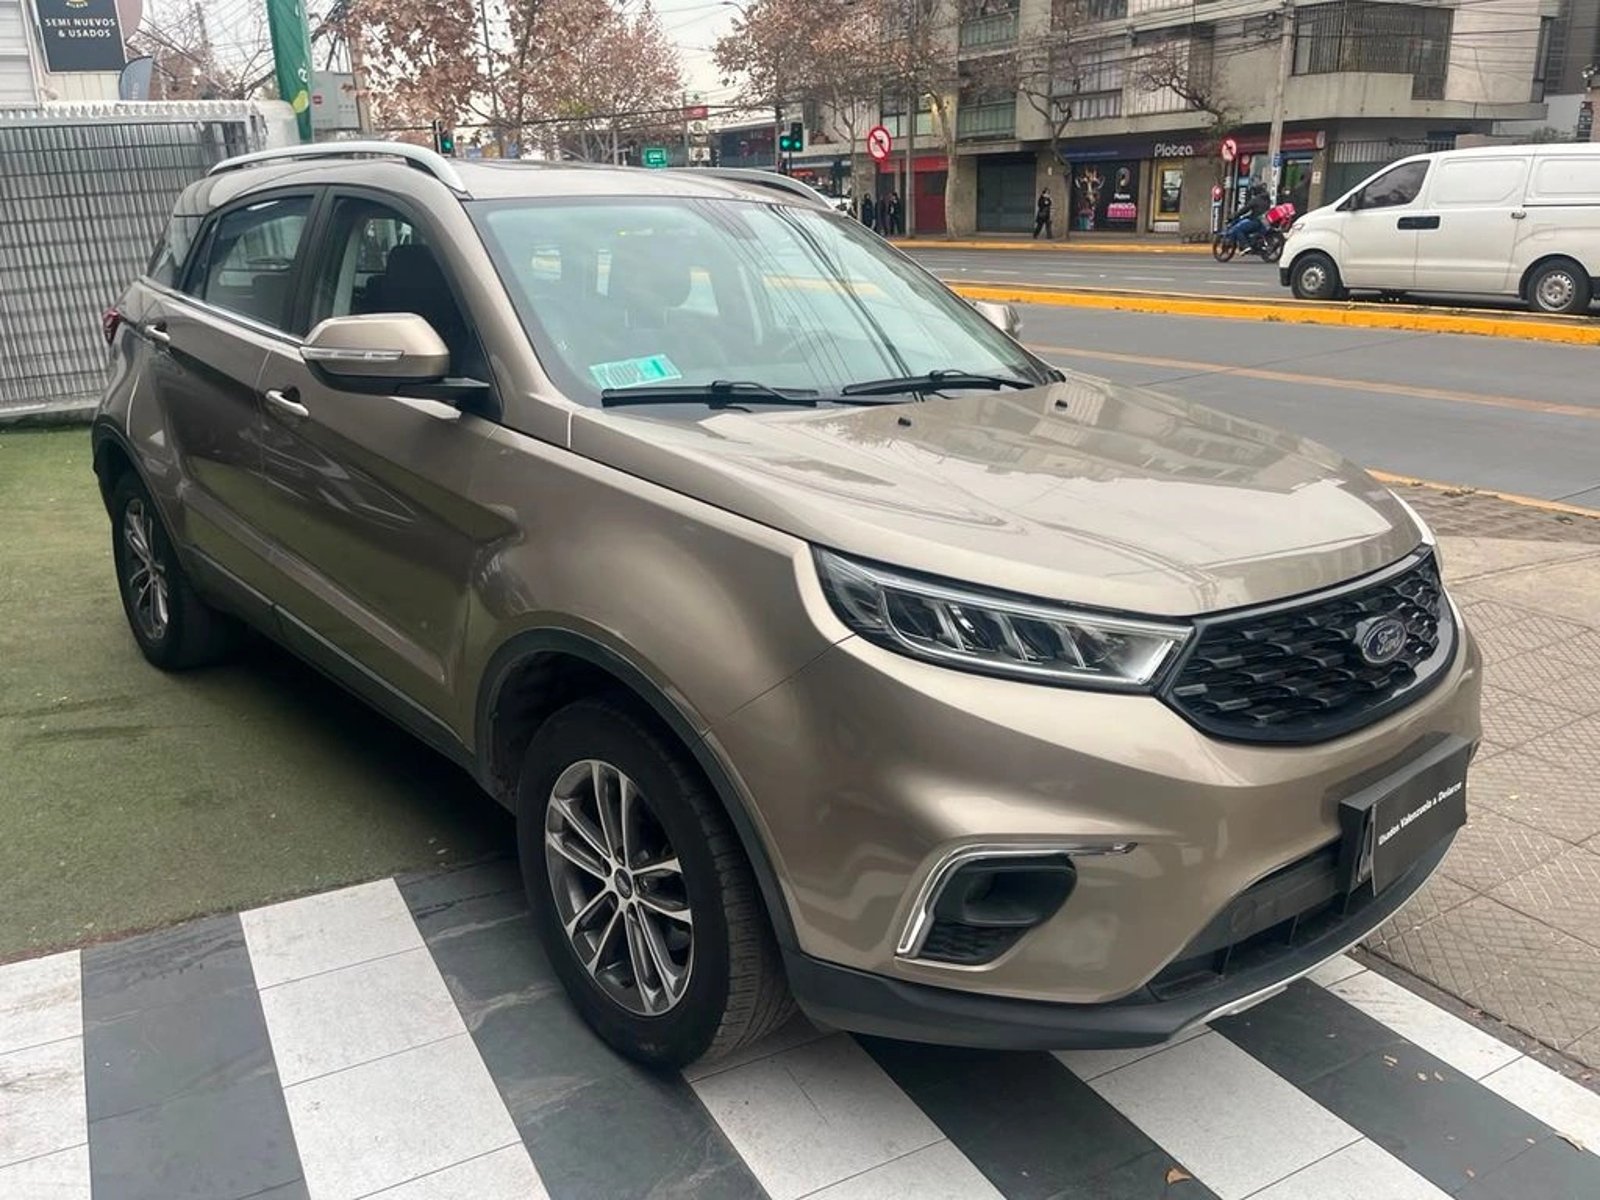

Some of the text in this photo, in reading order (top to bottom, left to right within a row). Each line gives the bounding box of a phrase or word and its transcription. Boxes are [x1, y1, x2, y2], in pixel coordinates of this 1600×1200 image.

[45, 18, 116, 27] SEMI NUEVOS
[58, 29, 111, 38] & USADOS
